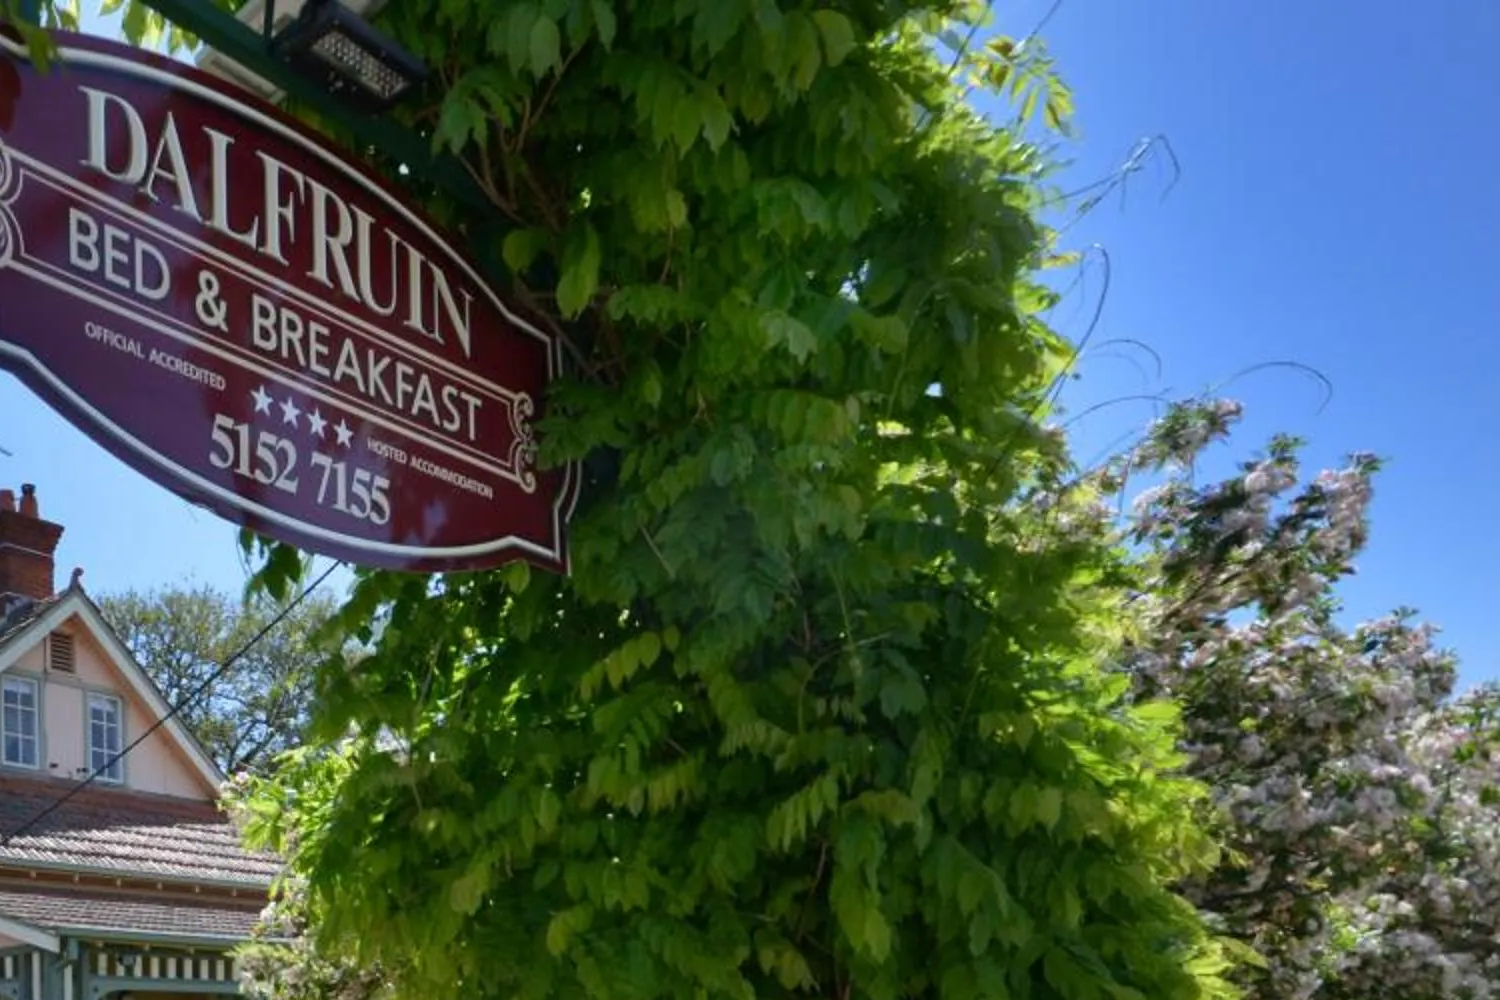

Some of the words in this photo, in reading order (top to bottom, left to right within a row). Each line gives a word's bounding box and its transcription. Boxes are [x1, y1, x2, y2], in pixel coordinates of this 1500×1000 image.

[78, 85, 476, 358] DALFRUIN
[68, 207, 171, 301] BED
[195, 270, 229, 333] &
[252, 293, 482, 441] BREAKFAST
[84, 321, 145, 359] OFFICIAL
[149, 347, 226, 391] ACCREDITED
[209, 412, 299, 495] 5152
[310, 451, 391, 525] 7155
[366, 436, 408, 465] HOSTED
